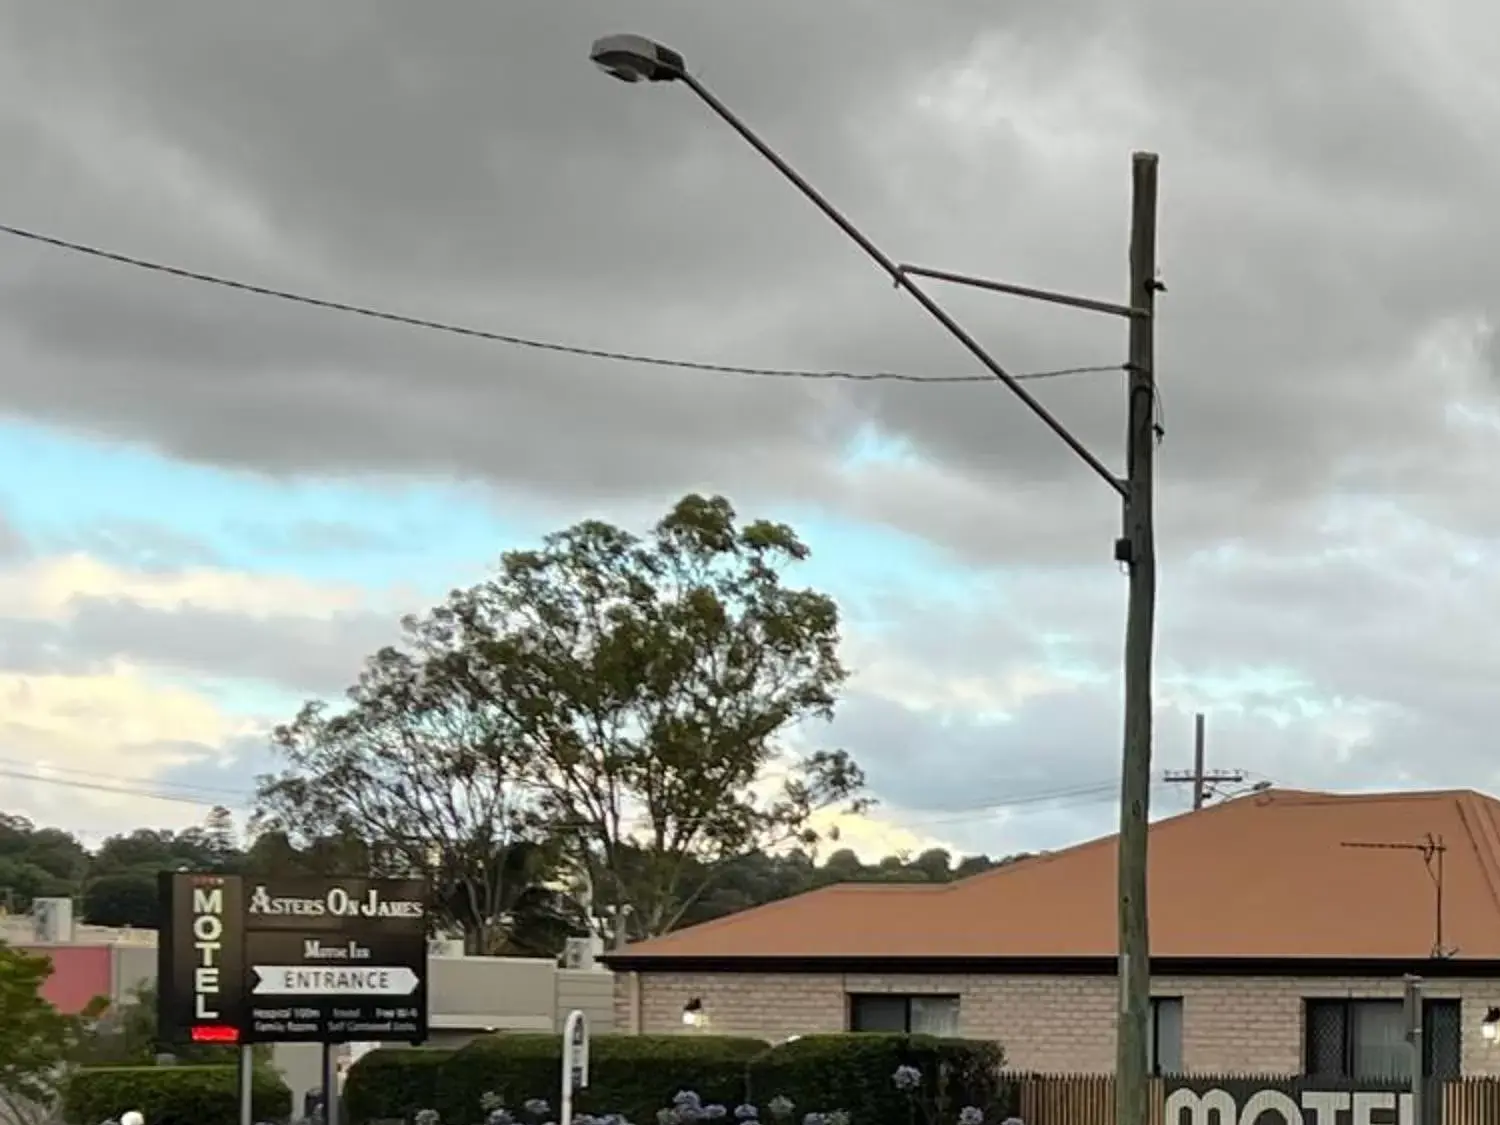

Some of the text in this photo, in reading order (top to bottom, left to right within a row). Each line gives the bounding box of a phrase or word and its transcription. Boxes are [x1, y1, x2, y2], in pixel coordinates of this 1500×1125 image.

[250, 886, 423, 917] ASTERS ON JAMES
[193, 888, 223, 1019] MOTEL
[284, 971, 389, 989] ENTRANCE
